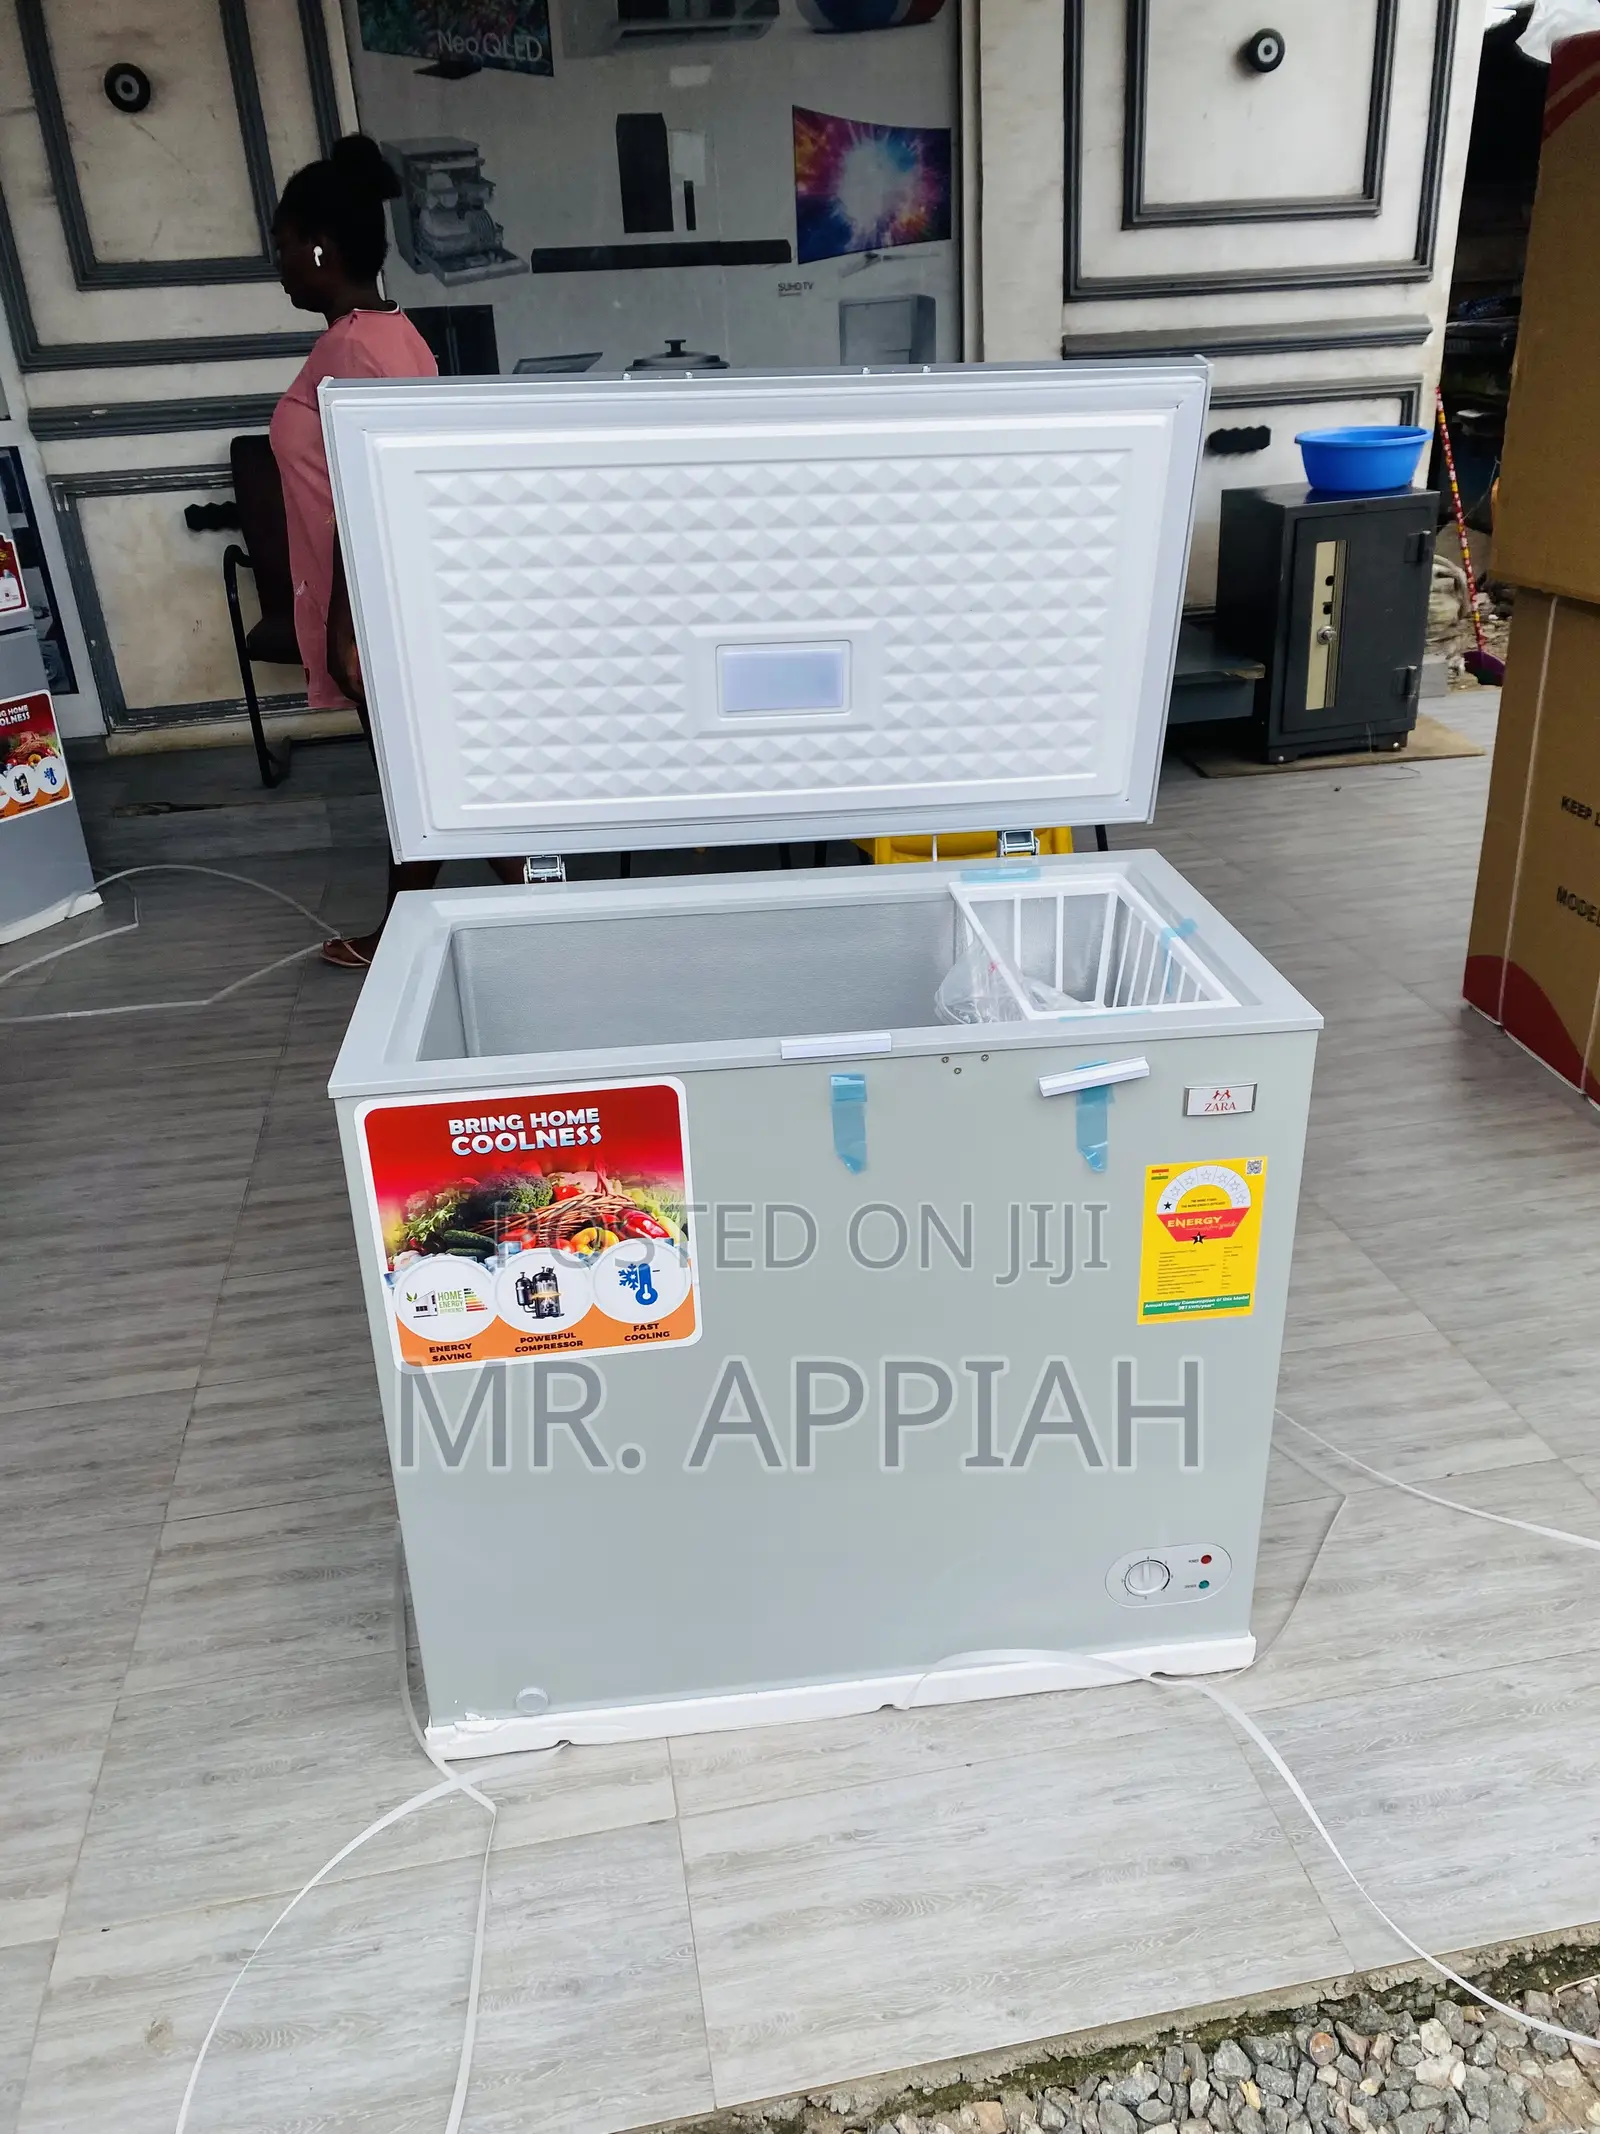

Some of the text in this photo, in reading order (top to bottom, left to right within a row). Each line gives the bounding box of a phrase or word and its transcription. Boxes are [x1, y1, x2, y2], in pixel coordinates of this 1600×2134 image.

[437, 29, 543, 62] Neo QLED
[7, 704, 29, 716] HOME
[1561, 795, 1593, 820] KEEP
[1204, 1101, 1237, 1112] ZARA
[448, 1107, 600, 1136] BRING HOME
[451, 1124, 602, 1156] COOLNESS
[1167, 1215, 1223, 1229] ENERGY
[437, 1290, 463, 1302] HOME
[439, 1300, 464, 1309] ENERGY
[633, 1322, 660, 1332] FAST
[520, 1332, 577, 1344] POWERFUL
[624, 1331, 670, 1342] COOLING
[429, 1342, 472, 1353] ENERGY
[515, 1340, 584, 1353] COMPRESSOR
[432, 1352, 473, 1362] SAVING
